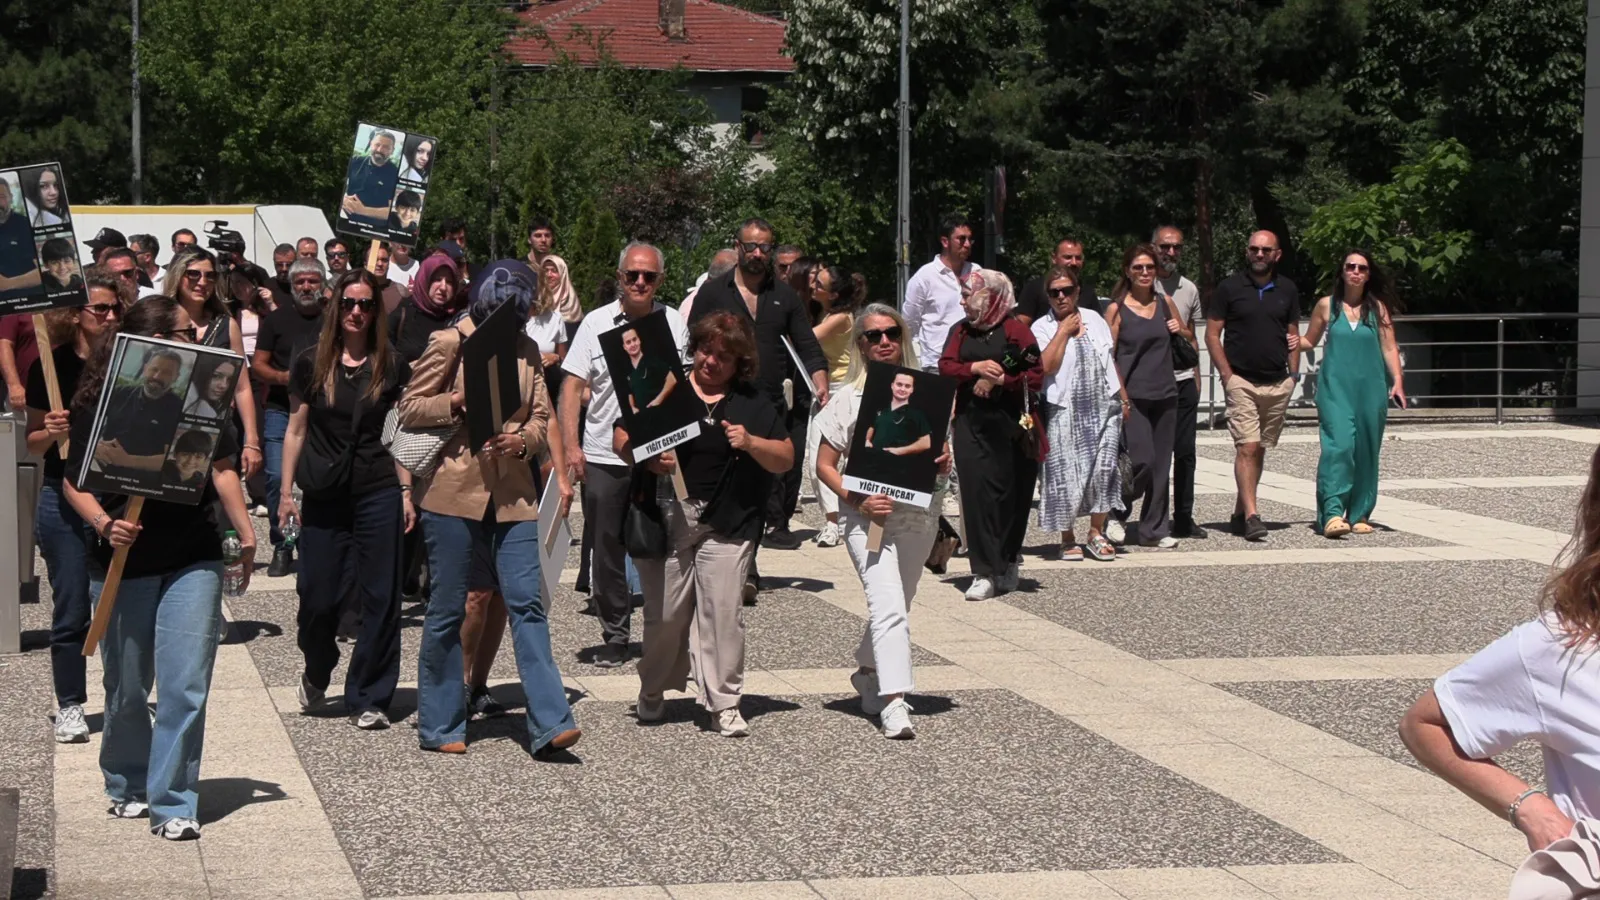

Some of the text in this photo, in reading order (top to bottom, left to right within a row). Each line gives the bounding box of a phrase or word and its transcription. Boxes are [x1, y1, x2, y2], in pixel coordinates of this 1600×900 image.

[661, 429, 688, 448] GENÇBAY
[859, 480, 916, 501] YİĞİT GENÇBAY
